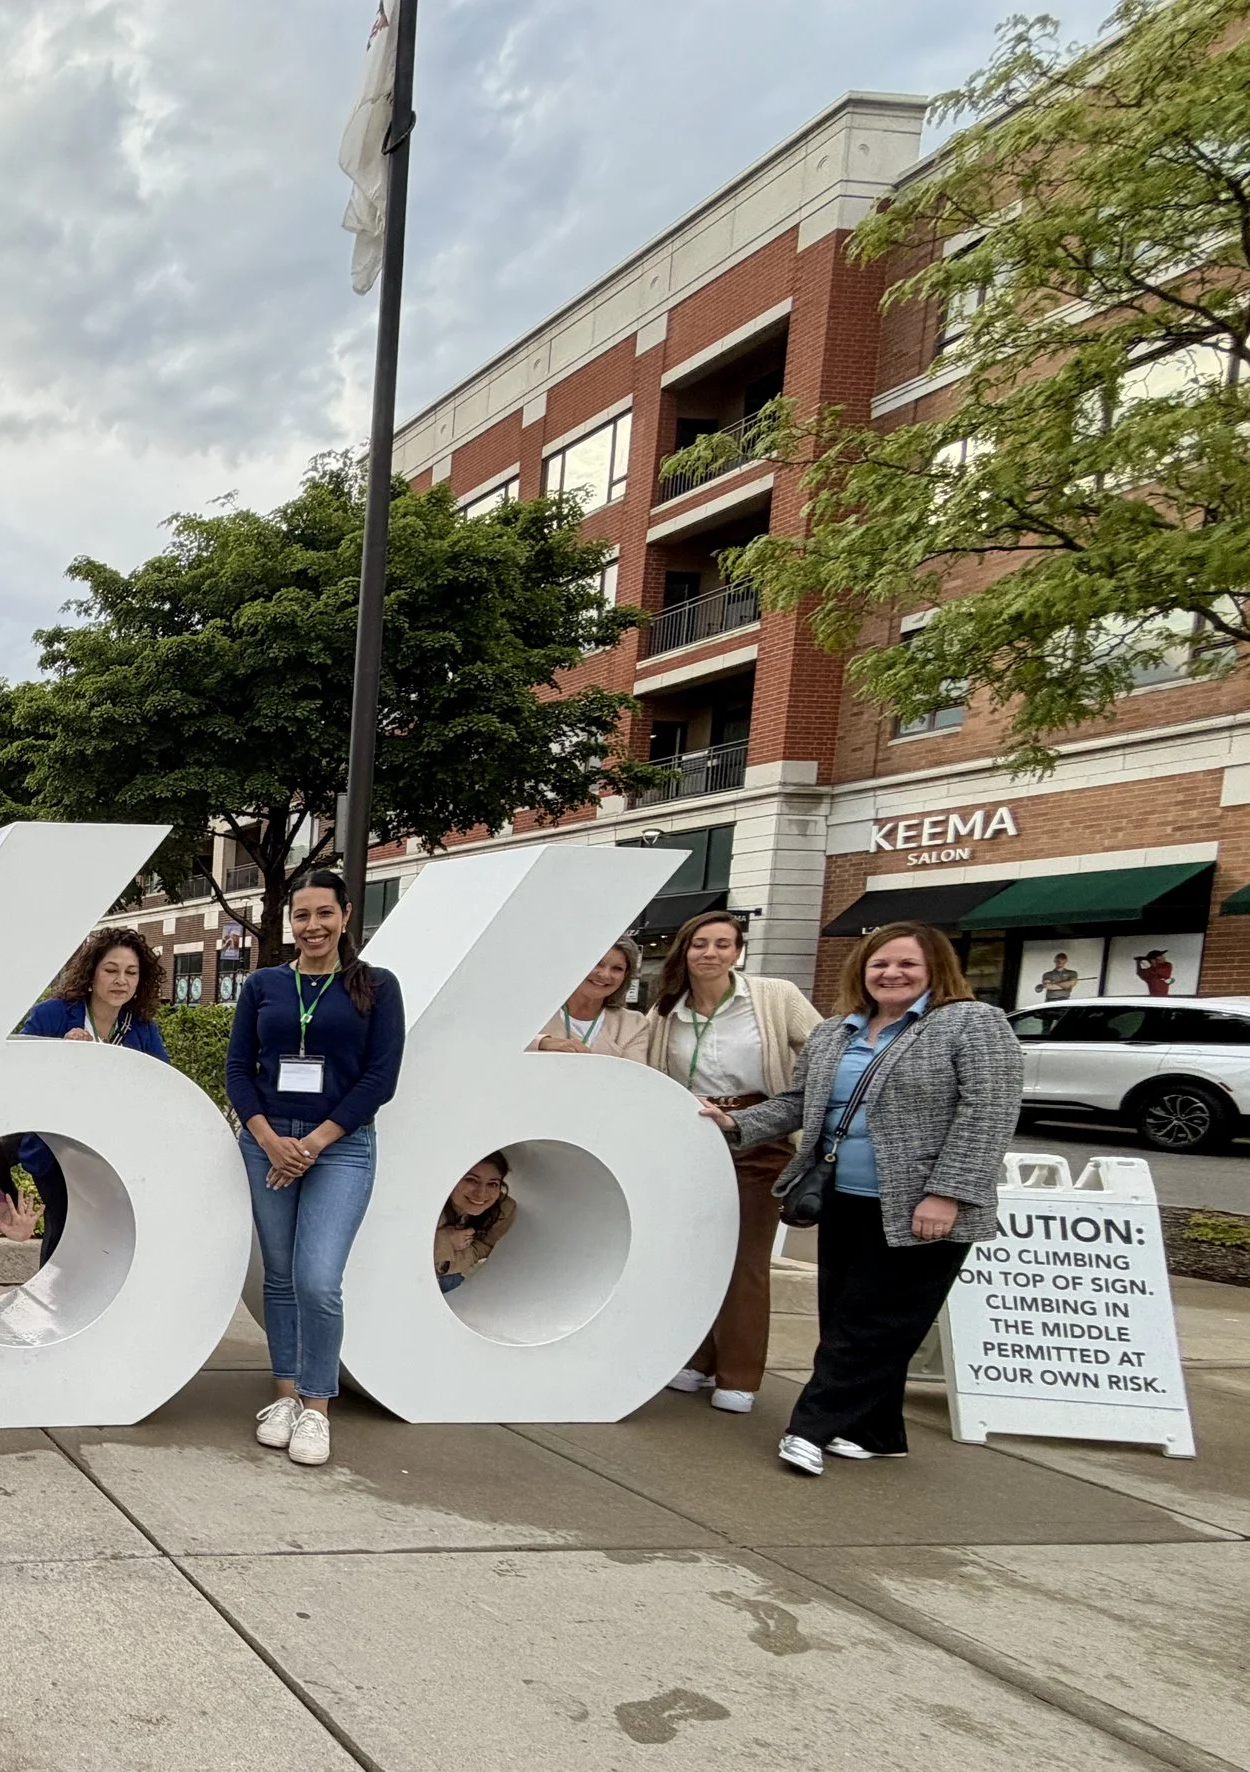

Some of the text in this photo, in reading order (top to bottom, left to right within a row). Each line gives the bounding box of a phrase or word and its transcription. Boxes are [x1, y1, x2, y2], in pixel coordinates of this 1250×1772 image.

[869, 806, 1018, 853] KEEMA
[907, 847, 972, 866] SALON
[997, 1213, 1145, 1246] UTION:
[976, 1246, 1130, 1271] NO CLIMBING
[958, 1268, 1154, 1296] ON TOP OF SIGN.
[986, 1294, 1129, 1318] CLIMBING IN
[990, 1318, 1131, 1342] THE MIDDLE
[982, 1341, 1145, 1367] PERMITTED AT
[968, 1364, 1166, 1394] YOUR OWN RISK.
